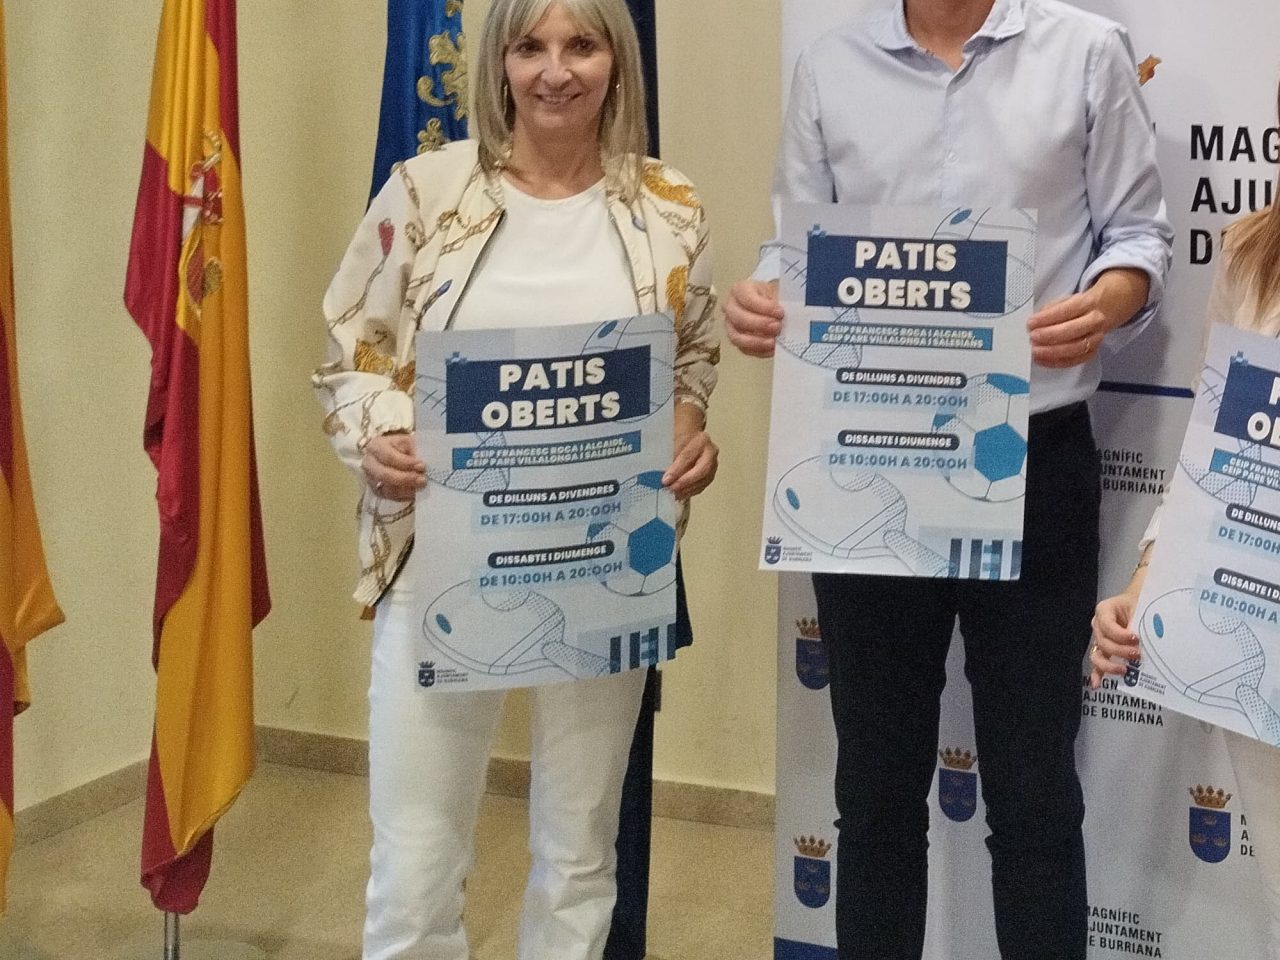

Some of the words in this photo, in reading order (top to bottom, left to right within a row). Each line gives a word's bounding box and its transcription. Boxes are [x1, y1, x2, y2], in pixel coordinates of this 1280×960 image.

[854, 240, 957, 272] PATIS
[836, 276, 971, 309] OBERTS
[499, 357, 606, 392] PATIS
[841, 371, 855, 380] DE
[856, 372, 896, 382] DILLUNS
[906, 374, 961, 385] DIVENDRES
[832, 391, 850, 402] DE
[854, 392, 898, 404] 17:00H
[902, 393, 911, 404] A
[481, 391, 621, 430] OBERTS
[845, 434, 893, 445] DISSABTE
[899, 436, 951, 447] DIUMENGE
[828, 453, 846, 465] DE
[850, 454, 895, 466] 10:00H
[900, 456, 910, 467] A
[489, 494, 502, 503] DE
[504, 491, 546, 504] DILLUNS
[558, 484, 613, 500] DIVENDRES
[481, 513, 498, 525] DE
[503, 509, 550, 525] 17:00H
[1230, 509, 1244, 520] DE
[1218, 526, 1235, 540] DE
[1237, 531, 1280, 554] 17:00H
[495, 552, 546, 566] DISSABTE
[554, 545, 606, 560] DIUMENGE
[480, 575, 498, 587] DE
[503, 571, 551, 586] 10:00H
[1220, 572, 1266, 595] DISSABTE
[1200, 589, 1218, 604] DE
[1219, 595, 1266, 619] 10:00H
[1083, 704, 1098, 716] DE
[1102, 707, 1164, 727] BURRIANA
[1089, 921, 1163, 943] JUNTAMENT
[1100, 937, 1162, 958] BURRIANA
